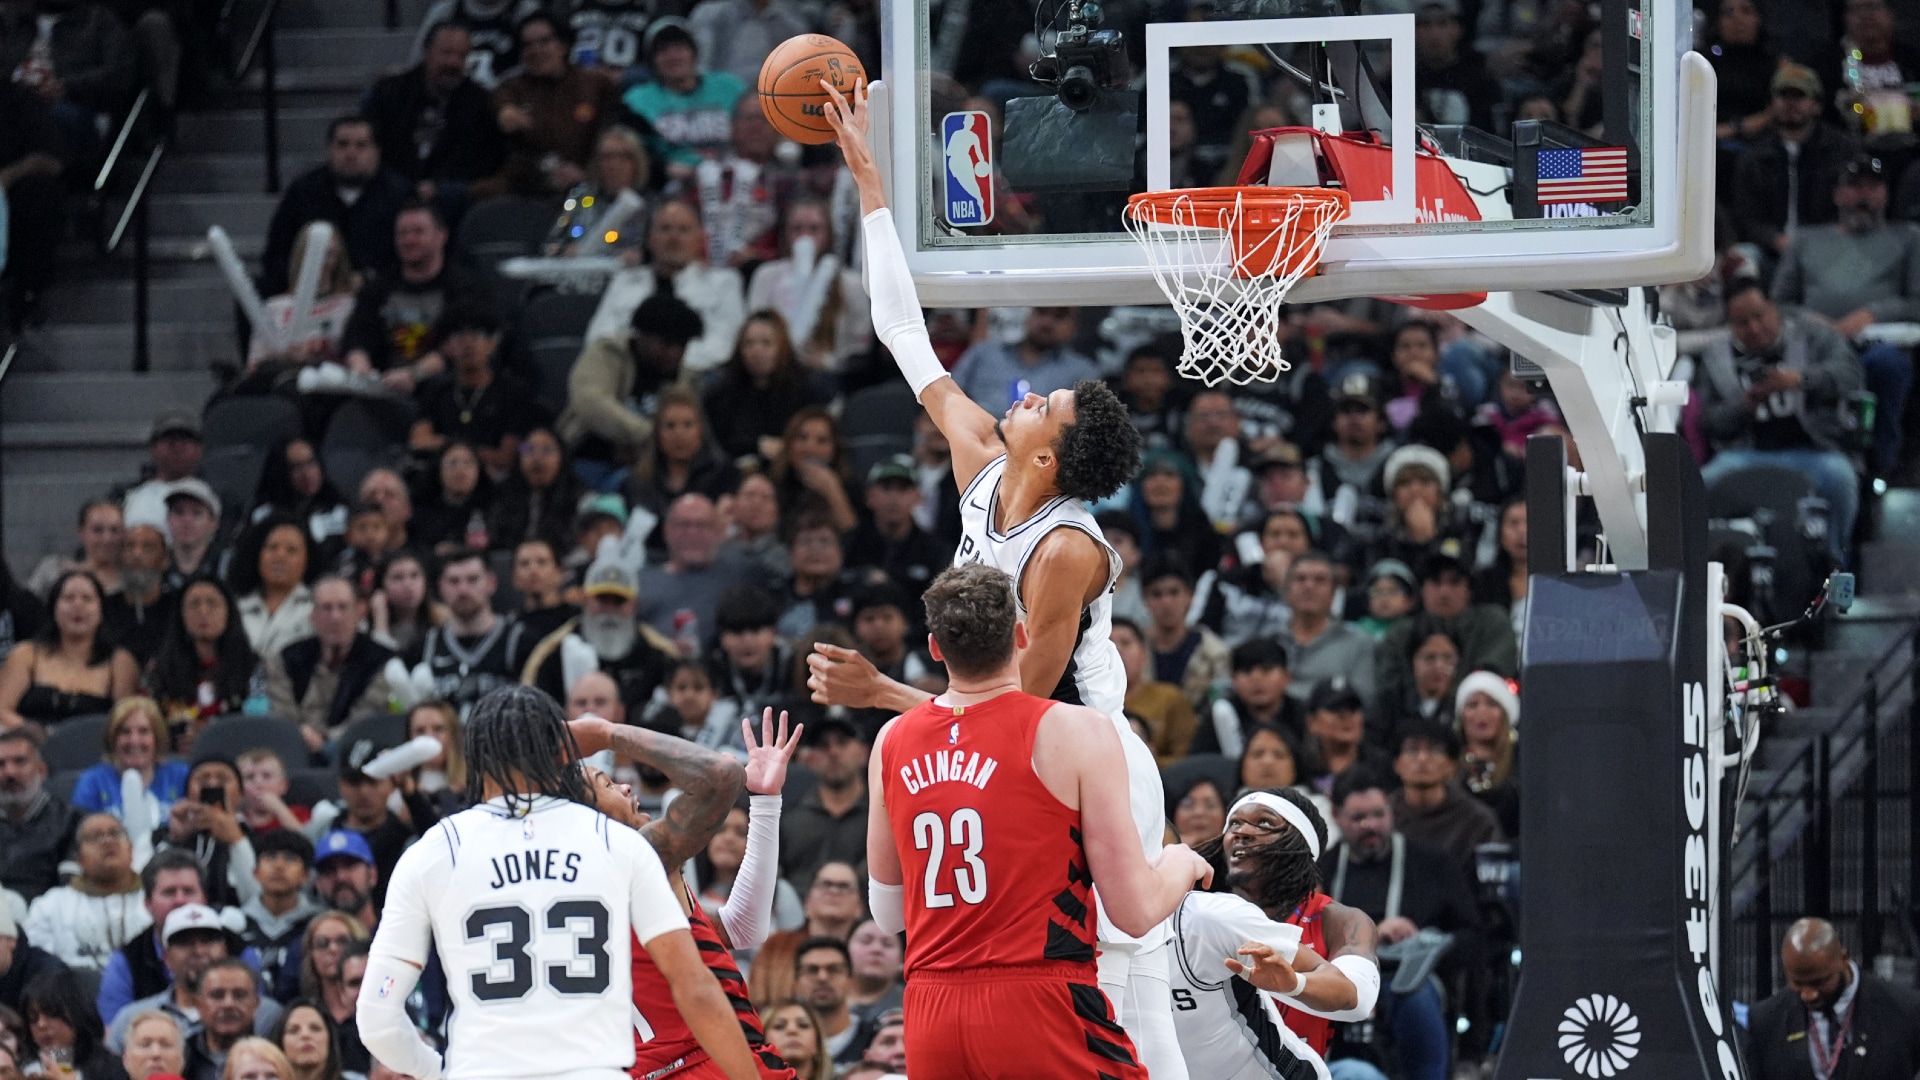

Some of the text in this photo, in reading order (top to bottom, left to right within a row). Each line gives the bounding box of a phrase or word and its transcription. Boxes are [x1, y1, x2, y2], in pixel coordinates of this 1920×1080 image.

[952, 200, 975, 219] NBA
[900, 750, 998, 795] CLINGAN
[490, 849, 581, 889] JONES
[913, 807, 988, 909] 23
[463, 897, 611, 1005] 33
